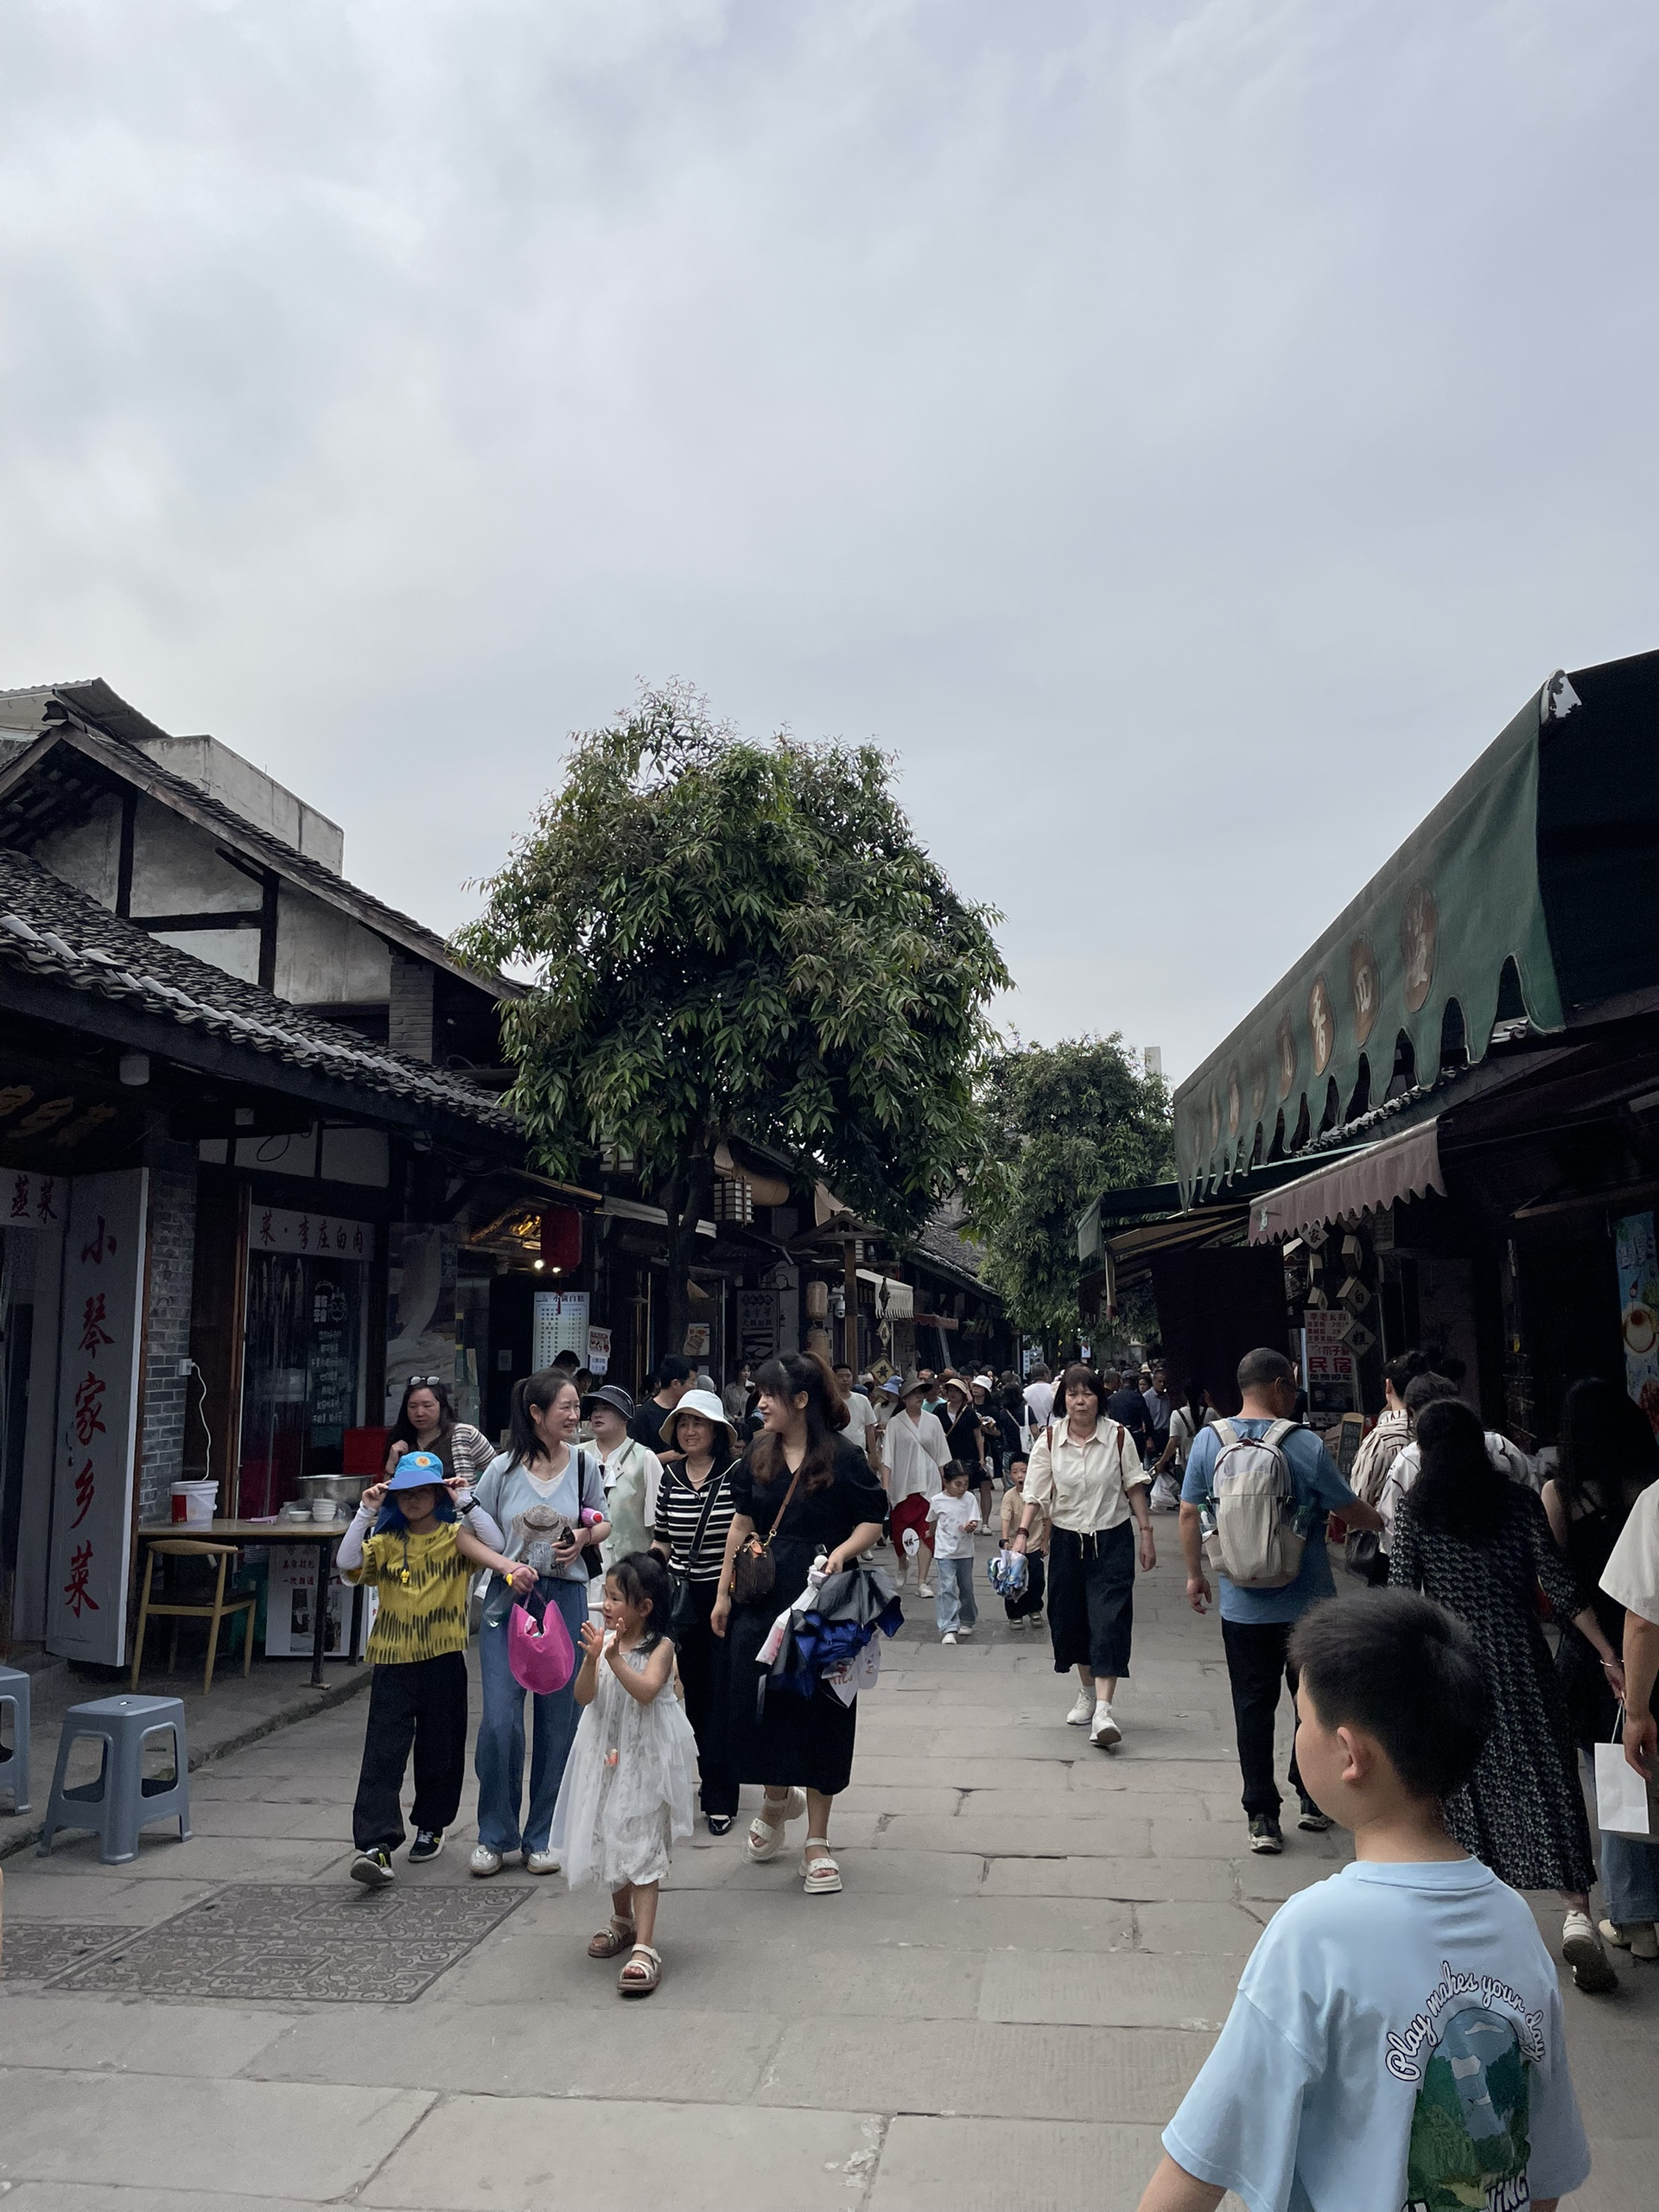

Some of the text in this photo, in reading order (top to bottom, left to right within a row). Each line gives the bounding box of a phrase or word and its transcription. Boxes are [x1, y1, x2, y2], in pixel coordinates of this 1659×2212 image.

[64, 1215, 117, 1618] 小琴家乡菜
[1309, 1357, 1351, 1373] 民宿
[1385, 1960, 1546, 2082] Play makes your day
